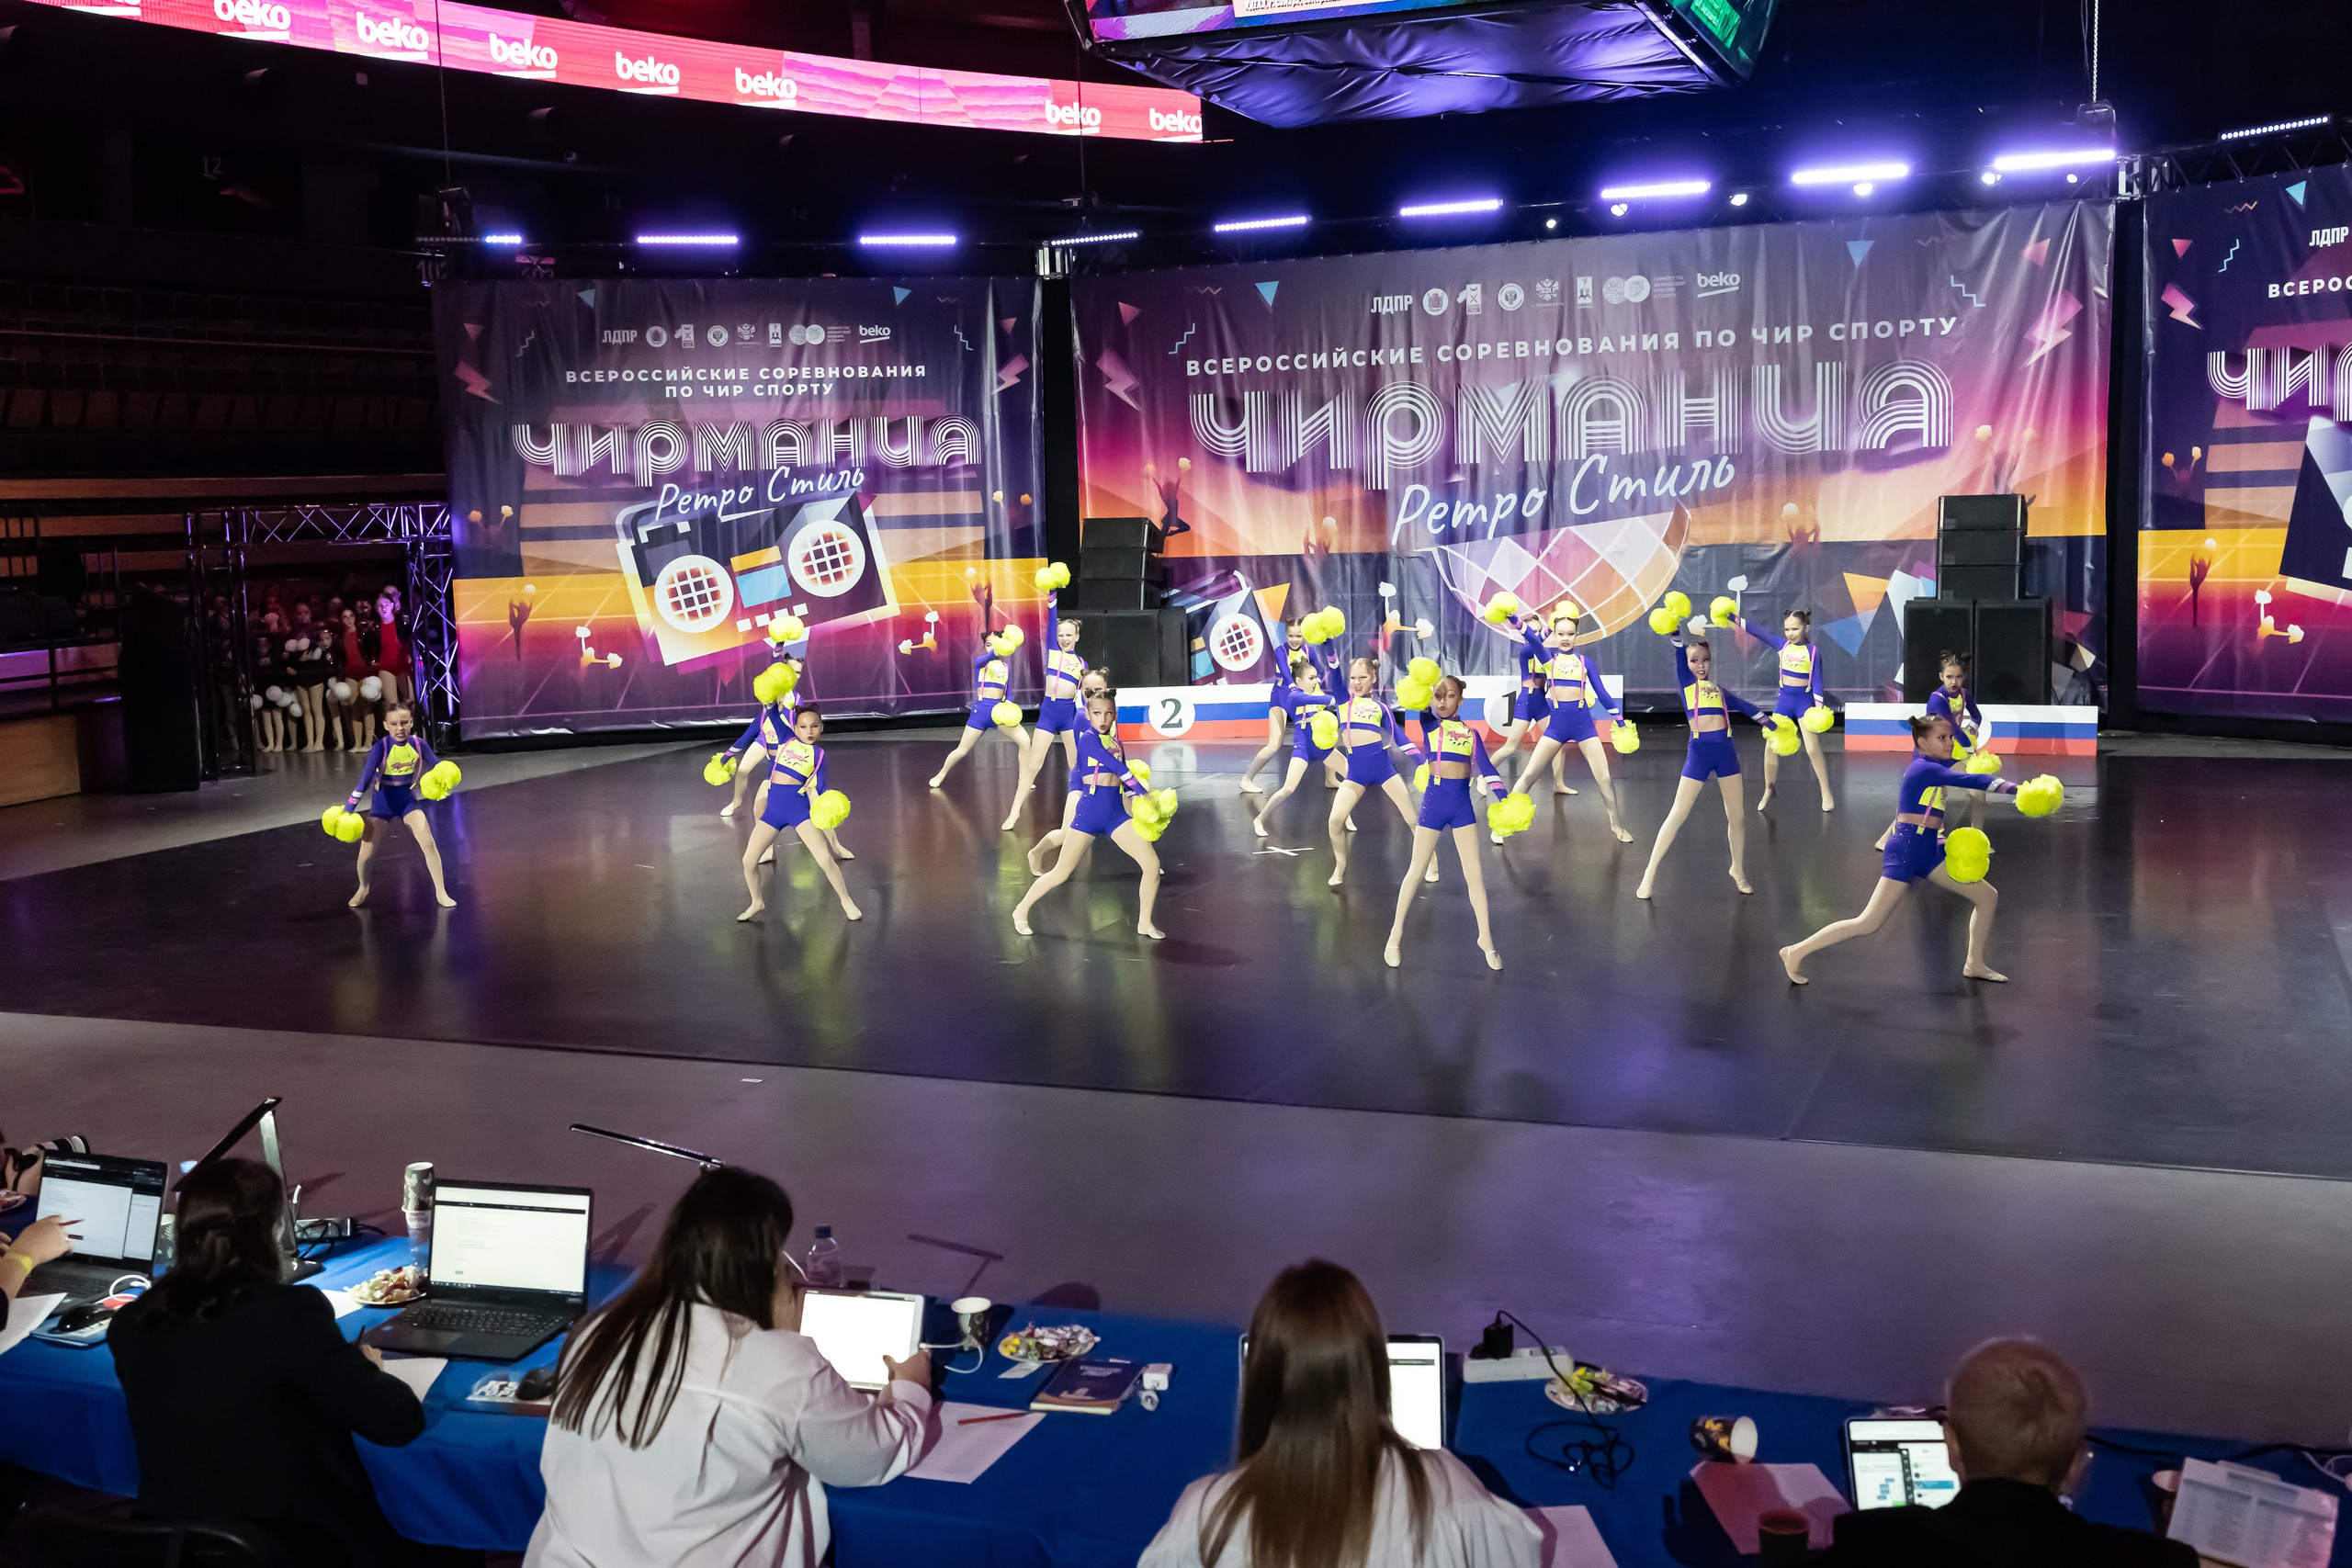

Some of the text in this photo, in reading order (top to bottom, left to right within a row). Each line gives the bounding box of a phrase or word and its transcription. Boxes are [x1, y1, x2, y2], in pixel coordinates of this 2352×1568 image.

[214, 0, 290, 30] beko
[356, 12, 429, 51] beko
[490, 33, 558, 70] beko
[616, 52, 679, 86] beko
[735, 68, 797, 99] beko
[1046, 100, 1101, 127] beko
[1149, 107, 1202, 133] beko
[200, 155, 222, 175] 12
[2309, 227, 2349, 247] ЛДПР
[1697, 271, 1740, 288] beko
[1371, 295, 1413, 314] ЛДПР
[602, 330, 638, 344] ЛДПР
[859, 324, 890, 336] beko
[1187, 317, 1957, 376] ВСЕРОССИЙСКИЕ СОРЕВНОВАНИЯ ПО ЧИР СПОРТУ
[566, 365, 926, 382] ВСЕРОССИЙСКИЕ СОРЕВНОВАНИЯ
[665, 383, 833, 398] ПО ЧИР СПОРТУ
[656, 466, 865, 521] Ретро Стиль
[1391, 453, 1735, 546] Ретро Стиль
[1160, 698, 1183, 728] 2
[1502, 691, 1517, 727] 1
